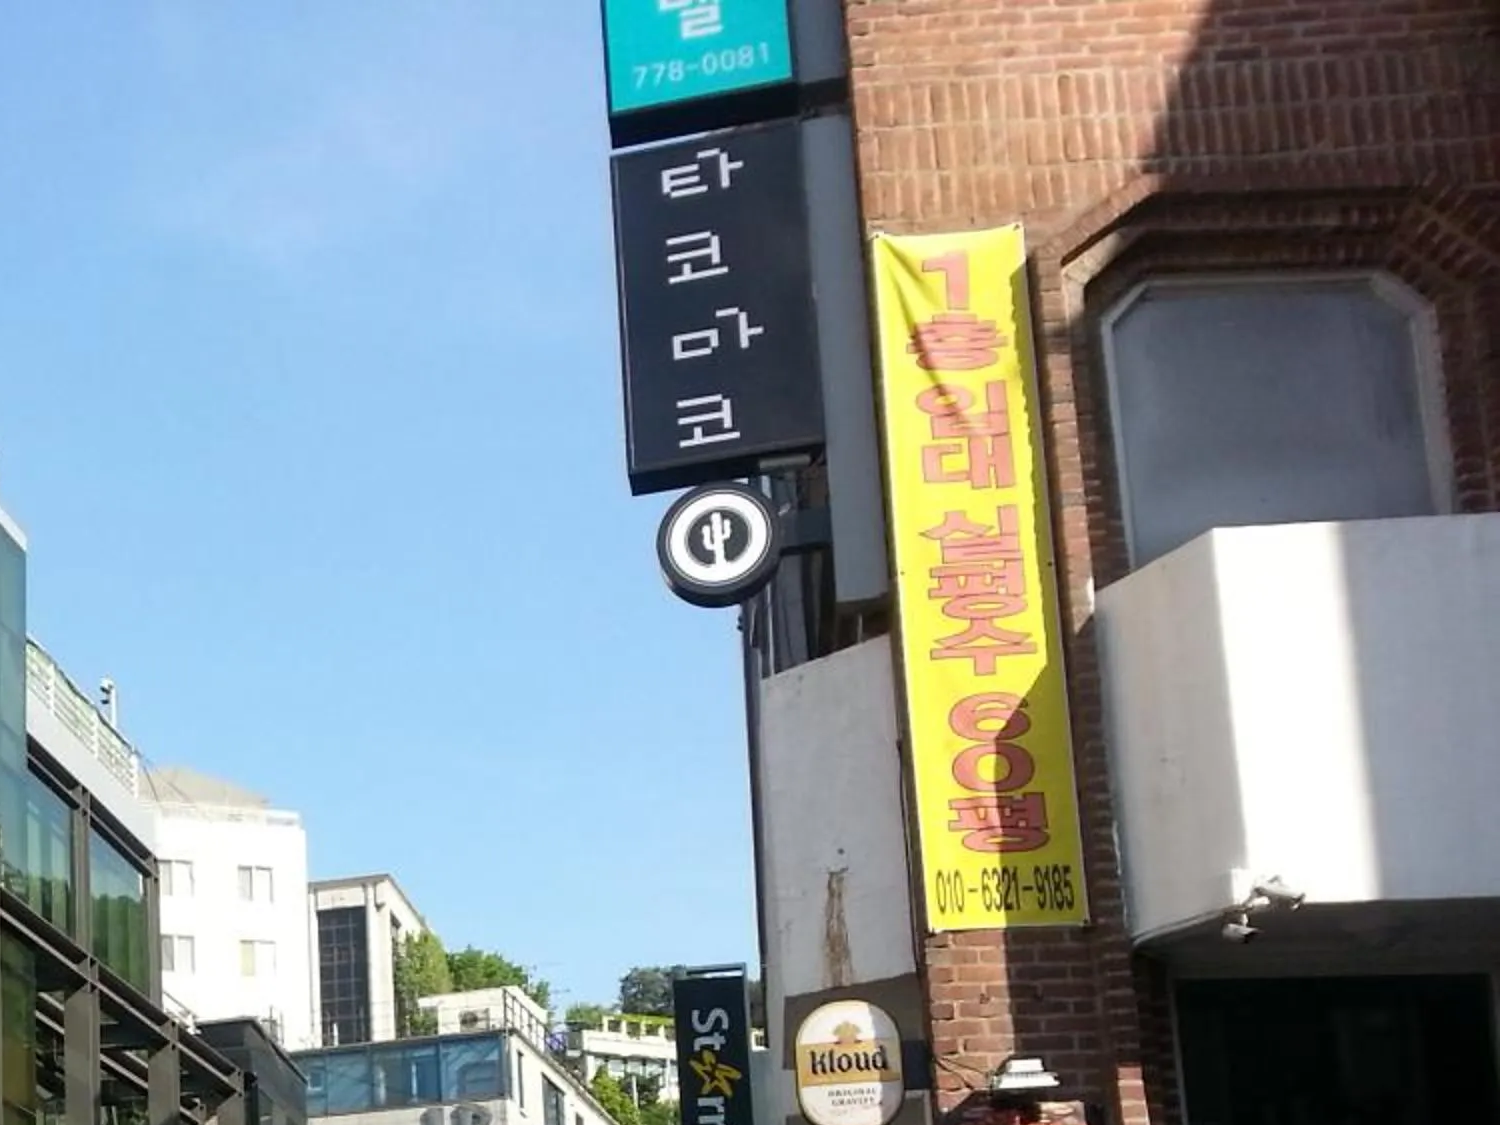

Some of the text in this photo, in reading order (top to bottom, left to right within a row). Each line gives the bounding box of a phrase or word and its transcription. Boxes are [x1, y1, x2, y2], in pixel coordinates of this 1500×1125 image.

[633, 41, 769, 90] 778-0081
[661, 147, 763, 448] 타코마코
[919, 505, 1038, 676] 실평수
[948, 692, 1051, 853] 60평
[809, 1044, 889, 1075] Kloud
